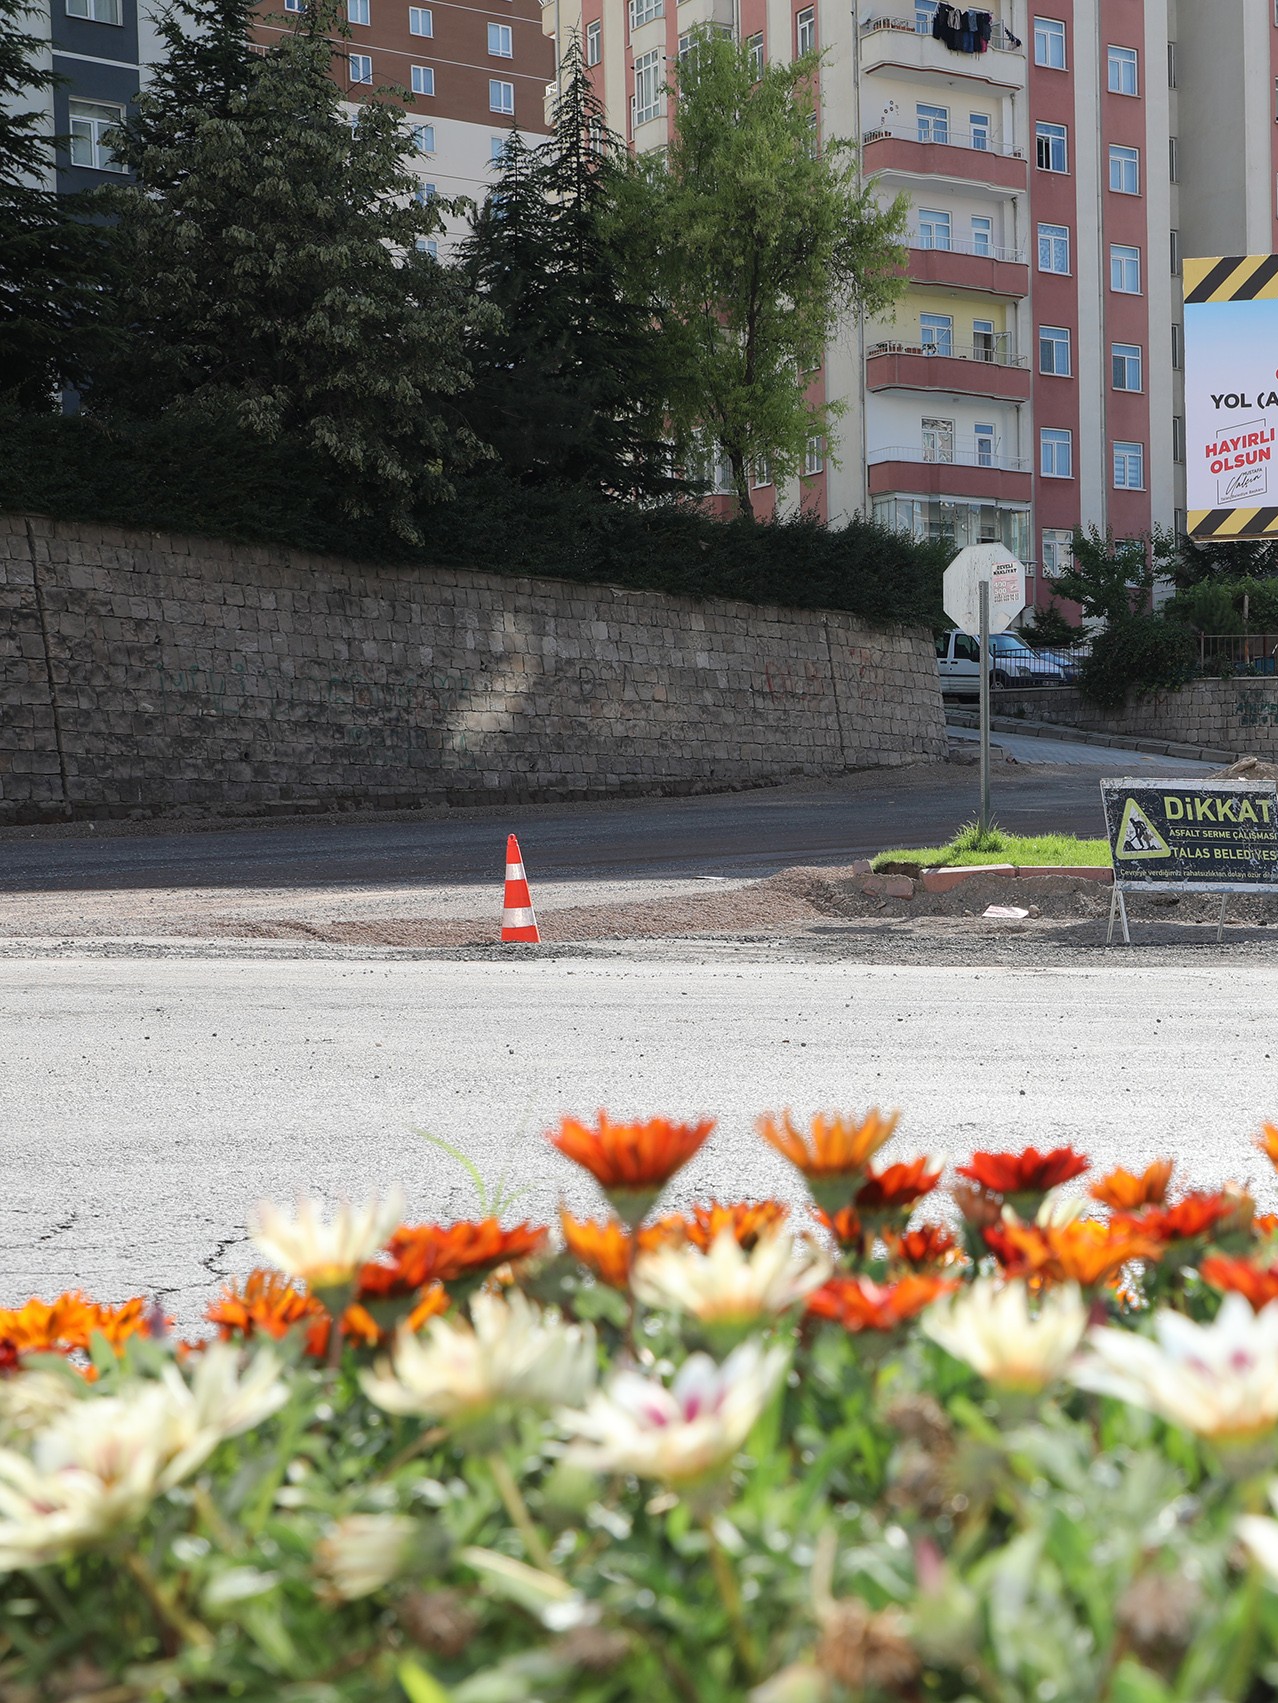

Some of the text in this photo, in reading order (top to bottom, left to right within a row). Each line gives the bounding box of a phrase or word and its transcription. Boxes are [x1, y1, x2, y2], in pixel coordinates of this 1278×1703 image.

[1210, 393, 1252, 410] YOL
[1205, 427, 1275, 458] HAYIRLI
[1210, 446, 1271, 474] OLSUN
[1169, 829, 1200, 838] ASFALT
[1202, 830, 1231, 839] SERME
[1172, 847, 1211, 859] TALAS
